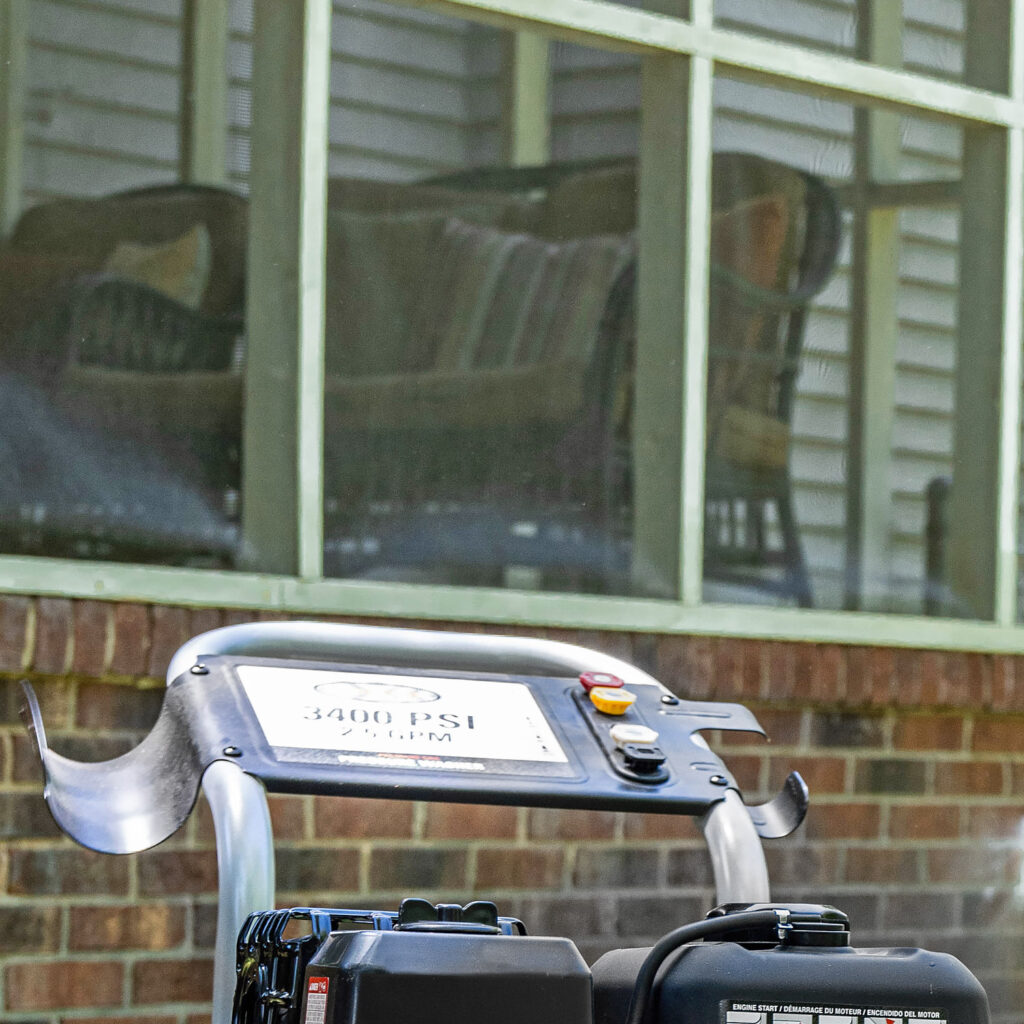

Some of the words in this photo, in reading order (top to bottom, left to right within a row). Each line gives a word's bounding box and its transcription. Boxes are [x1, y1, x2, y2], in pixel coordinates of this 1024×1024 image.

[303, 705, 392, 725] 3400
[410, 711, 475, 730] PSI
[732, 1003, 757, 1011] ENGINE
[758, 1004, 778, 1012] START
[783, 1004, 824, 1014] DÉMARRAGE
[835, 1007, 862, 1016] MOTEUR
[867, 1009, 903, 1017] ENCENDIDO
